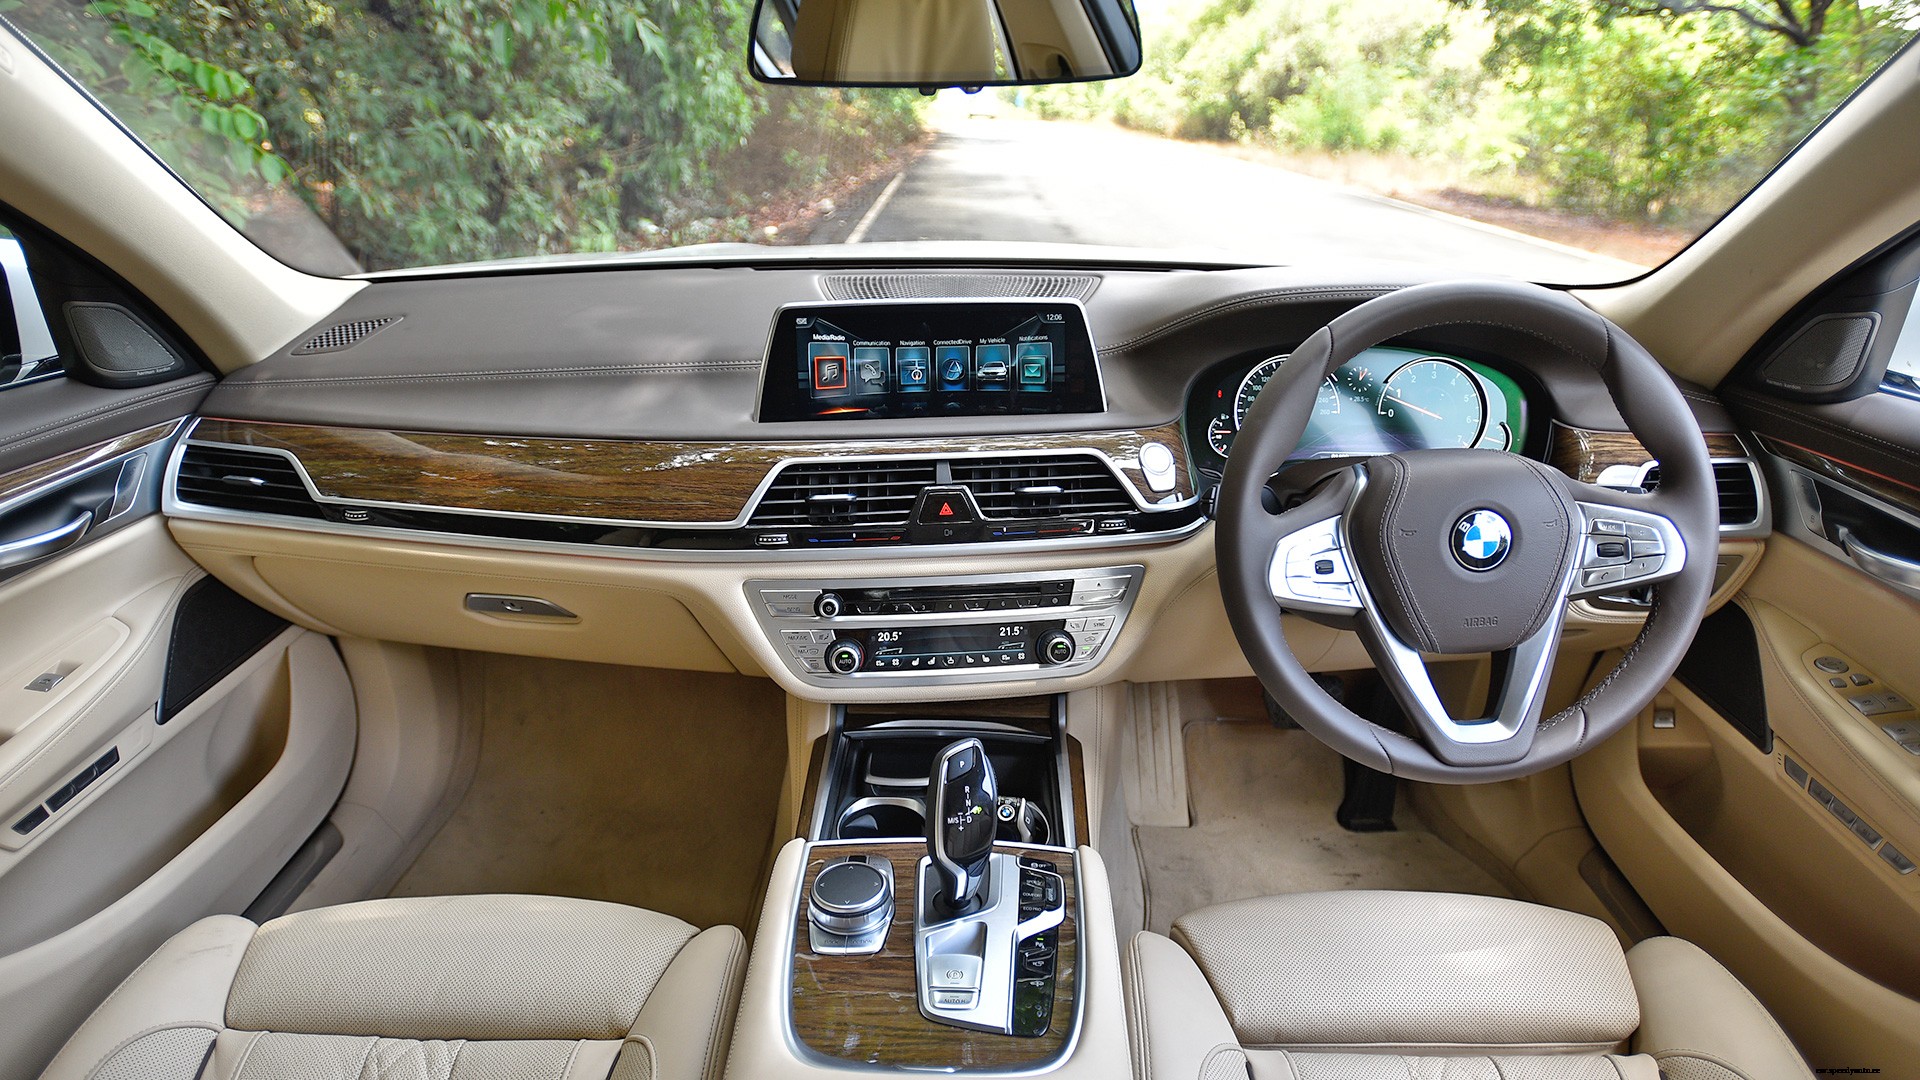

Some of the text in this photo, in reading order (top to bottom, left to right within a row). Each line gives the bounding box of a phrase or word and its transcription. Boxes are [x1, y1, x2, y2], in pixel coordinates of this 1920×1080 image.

[1411, 376, 1417, 384] 2
[1387, 408, 1395, 418] 0
[1462, 615, 1499, 628] AIRBAG
[959, 760, 965, 768] P
[964, 785, 971, 793] R
[965, 799, 972, 807] N
[947, 816, 972, 825] M/S D
